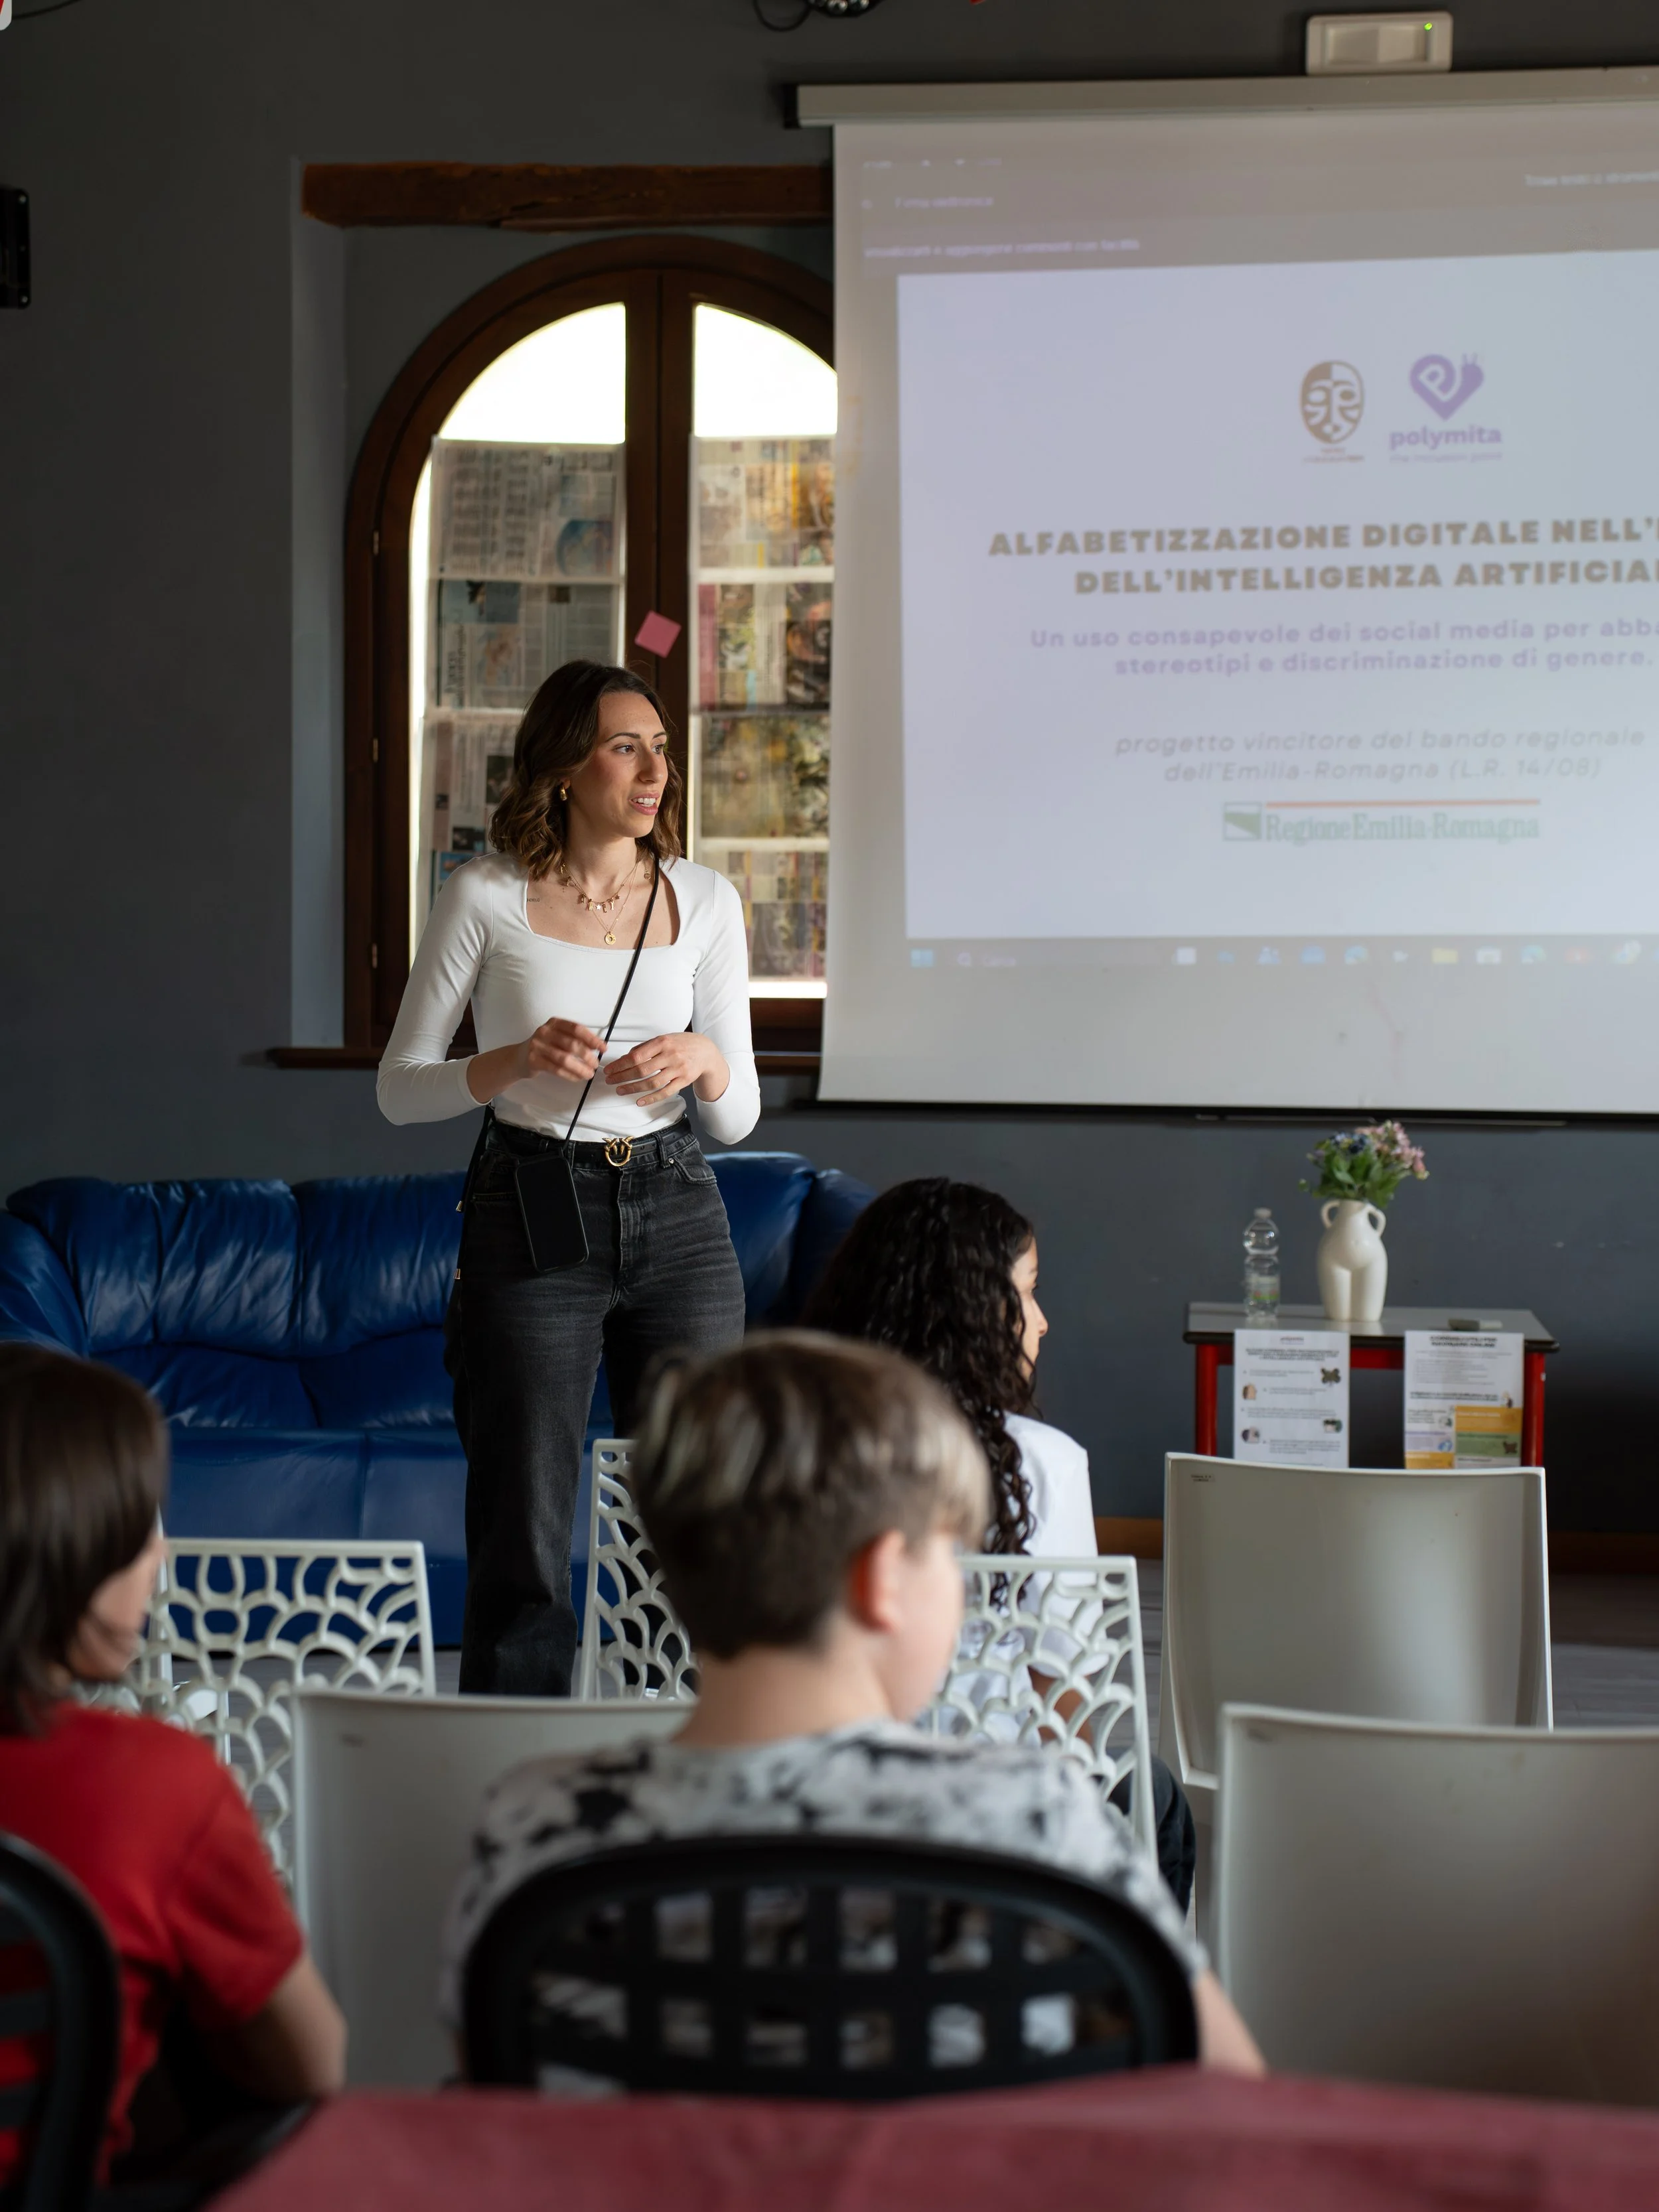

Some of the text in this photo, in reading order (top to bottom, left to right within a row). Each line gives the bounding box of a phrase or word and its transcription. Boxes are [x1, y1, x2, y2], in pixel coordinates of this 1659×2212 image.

[1389, 425, 1502, 451] polymita
[988, 516, 1659, 557] ALFABETIZZAZIONE DIGITALE NELL'
[1075, 565, 1443, 595] DELL'INTELLIGENZA
[1030, 630, 1064, 649] Un
[1072, 632, 1119, 648] uso
[1127, 624, 1301, 649] consapevole
[1309, 622, 1351, 644] dei
[1358, 621, 1441, 642] social
[1449, 619, 1535, 640] media
[1544, 623, 1591, 644] per
[1115, 647, 1653, 677] stereotipi e discriminazione di genere.
[1114, 726, 1645, 758] progetto vincitore del bando regionale
